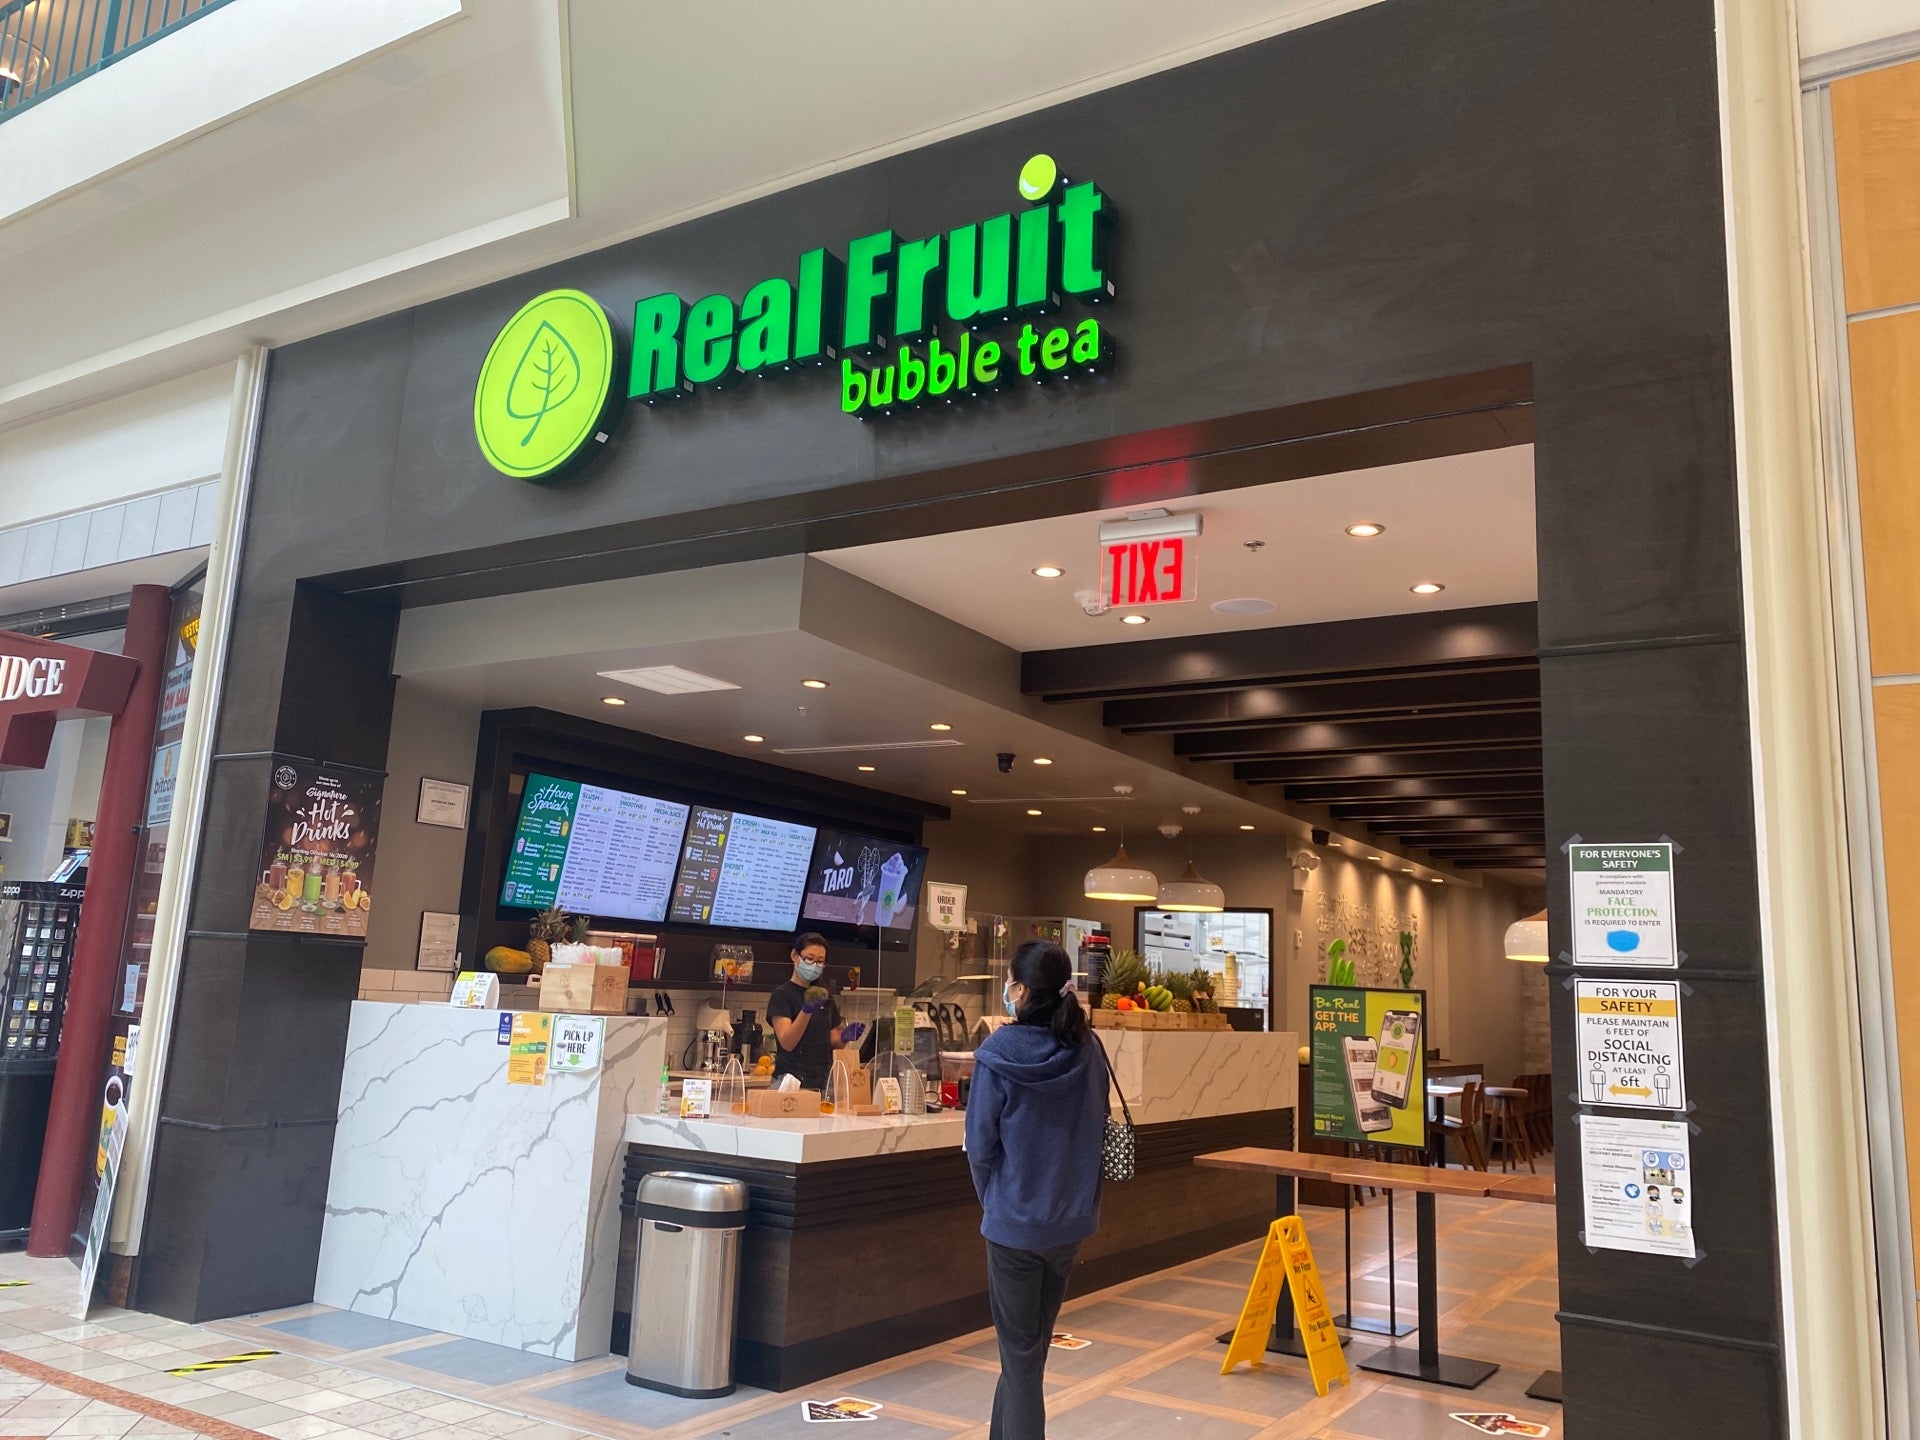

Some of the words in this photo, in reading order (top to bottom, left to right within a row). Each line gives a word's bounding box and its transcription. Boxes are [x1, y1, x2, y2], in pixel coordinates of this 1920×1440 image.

[627, 246, 828, 399] Real
[843, 154, 1104, 348] Fruit
[841, 336, 1001, 415] bubble
[1018, 318, 1101, 377] tea
[306, 787, 348, 800] Signature
[542, 783, 574, 800] House
[582, 792, 600, 801] SLUSH
[308, 799, 340, 825] Hot
[291, 819, 350, 845] Drinks
[277, 853, 289, 861] SM
[1580, 850, 1599, 858] FOR
[1601, 849, 1661, 858] EVERYONE'S
[1602, 860, 1639, 869] SAFETY
[822, 866, 854, 893] TARO
[937, 895, 956, 906] ORDER
[1608, 896, 1636, 906] FACE
[940, 905, 954, 916] HERE
[1587, 907, 1658, 917] PROTECTION
[1596, 987, 1619, 997] FOR
[1622, 988, 1657, 998] YOUR
[1314, 996, 1332, 1008] Be
[1333, 998, 1360, 1010] Real
[1600, 1000, 1654, 1013] SAFETY
[1314, 1010, 1334, 1022] GET
[1337, 1012, 1359, 1023] THE
[1586, 1017, 1619, 1026] PLEASE
[1621, 1019, 1670, 1028] MAINTAIN
[1314, 1021, 1338, 1033] APP.
[1613, 1028, 1634, 1036] FEET
[1637, 1029, 1650, 1037] OF
[563, 1029, 580, 1041] PICK
[583, 1031, 594, 1043] UP
[567, 1042, 587, 1054] HERE
[1604, 1039, 1654, 1051] SOCIAL
[1588, 1051, 1671, 1066] DISTANCING
[1624, 1067, 1647, 1075] LEAST
[1620, 1076, 1641, 1087] 6ft
